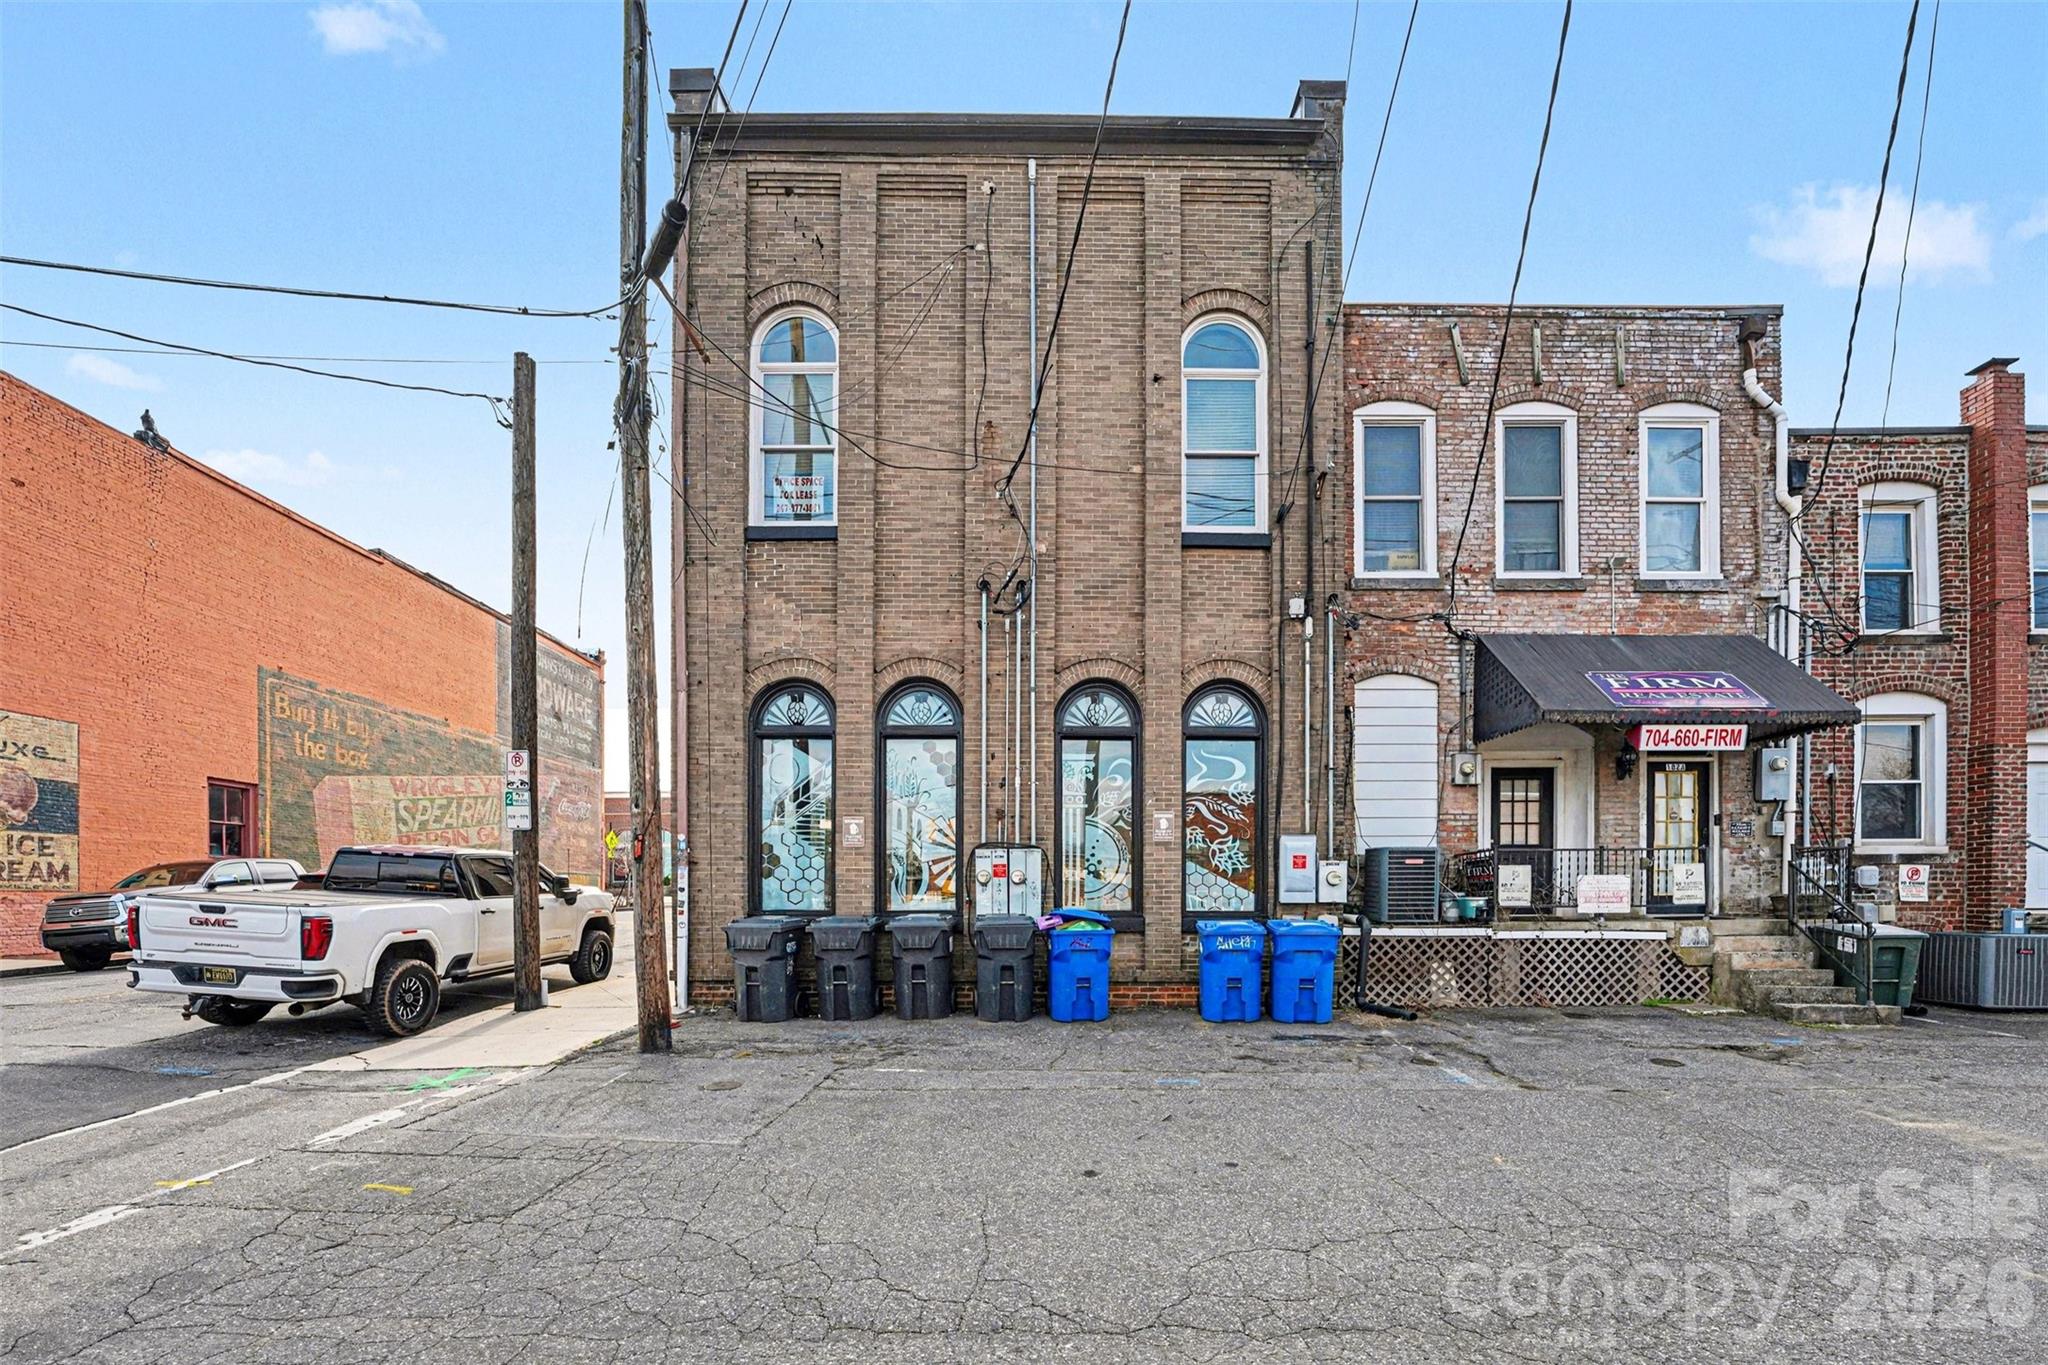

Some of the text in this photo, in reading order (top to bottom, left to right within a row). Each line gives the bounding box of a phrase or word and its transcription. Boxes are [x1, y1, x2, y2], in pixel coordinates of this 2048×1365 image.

[795, 490, 817, 499] LEASE
[1606, 677, 1738, 689] FIRM
[274, 690, 317, 734] Buy
[345, 711, 369, 748] by
[1645, 727, 1743, 748] 704-660-FIRM
[295, 731, 369, 770] the box
[506, 794, 513, 804] 2
[6, 833, 55, 857] ICE
[189, 916, 239, 929] GMC
